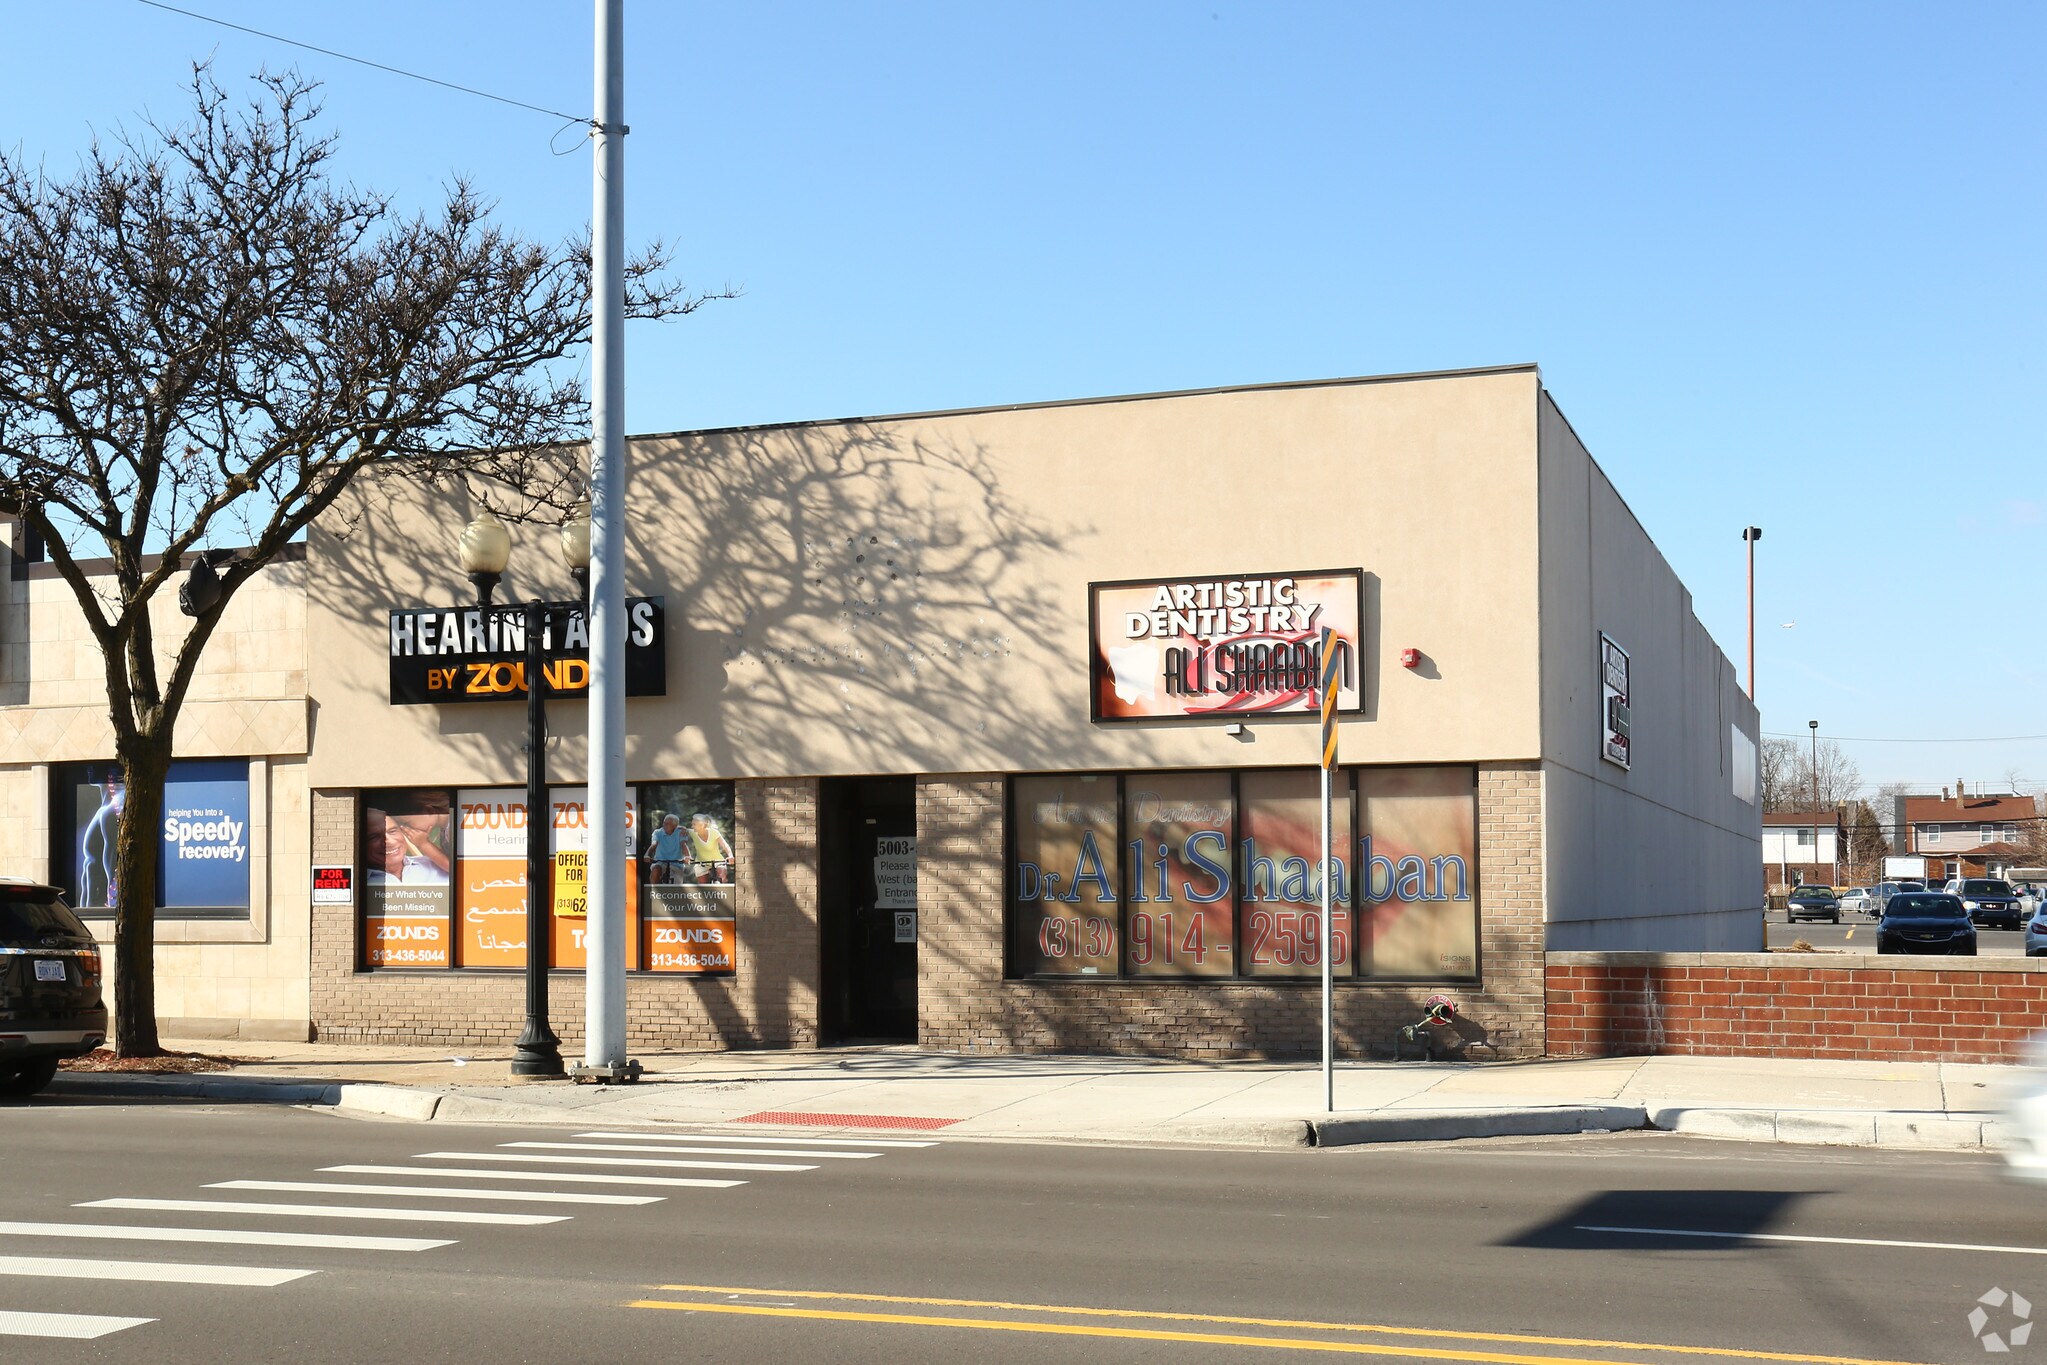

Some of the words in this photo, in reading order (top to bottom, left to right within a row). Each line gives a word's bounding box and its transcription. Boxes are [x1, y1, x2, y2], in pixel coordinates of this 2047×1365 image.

[1150, 578, 1295, 612] ARTISTIC
[564, 601, 654, 650] AS
[1126, 603, 1321, 639] DENTISTRY
[427, 668, 457, 691] BY
[466, 659, 589, 694] ZOUND
[1163, 646, 1206, 694] ALI
[169, 808, 191, 818] helping
[192, 808, 204, 817] You
[461, 803, 528, 830] ZOUND
[553, 801, 634, 829] ZOUS
[1032, 791, 1115, 825] Artitic
[1128, 790, 1232, 827] Dentistry
[164, 815, 244, 846] Speedy
[179, 845, 246, 862] recovery
[879, 840, 917, 856] 5003-
[321, 869, 344, 879] FOR
[880, 861, 909, 871] Please
[566, 868, 583, 881] FOR
[877, 875, 900, 884] West
[315, 879, 349, 889] RENT
[374, 890, 394, 899] Hear
[395, 890, 416, 899] What
[417, 890, 443, 899] You've
[650, 890, 702, 900] Reconnect
[703, 890, 728, 900] With
[382, 903, 403, 911] Been
[404, 903, 435, 913] Missing
[662, 903, 684, 912] Your
[687, 903, 717, 912] World
[377, 925, 440, 941] ZOUNDS
[655, 928, 724, 944] ZOUNDS
[1039, 917, 1115, 958] (313)
[1250, 911, 1349, 966] 2595
[373, 949, 446, 962] 313-436-5044
[651, 953, 730, 967] 313-436-5044
